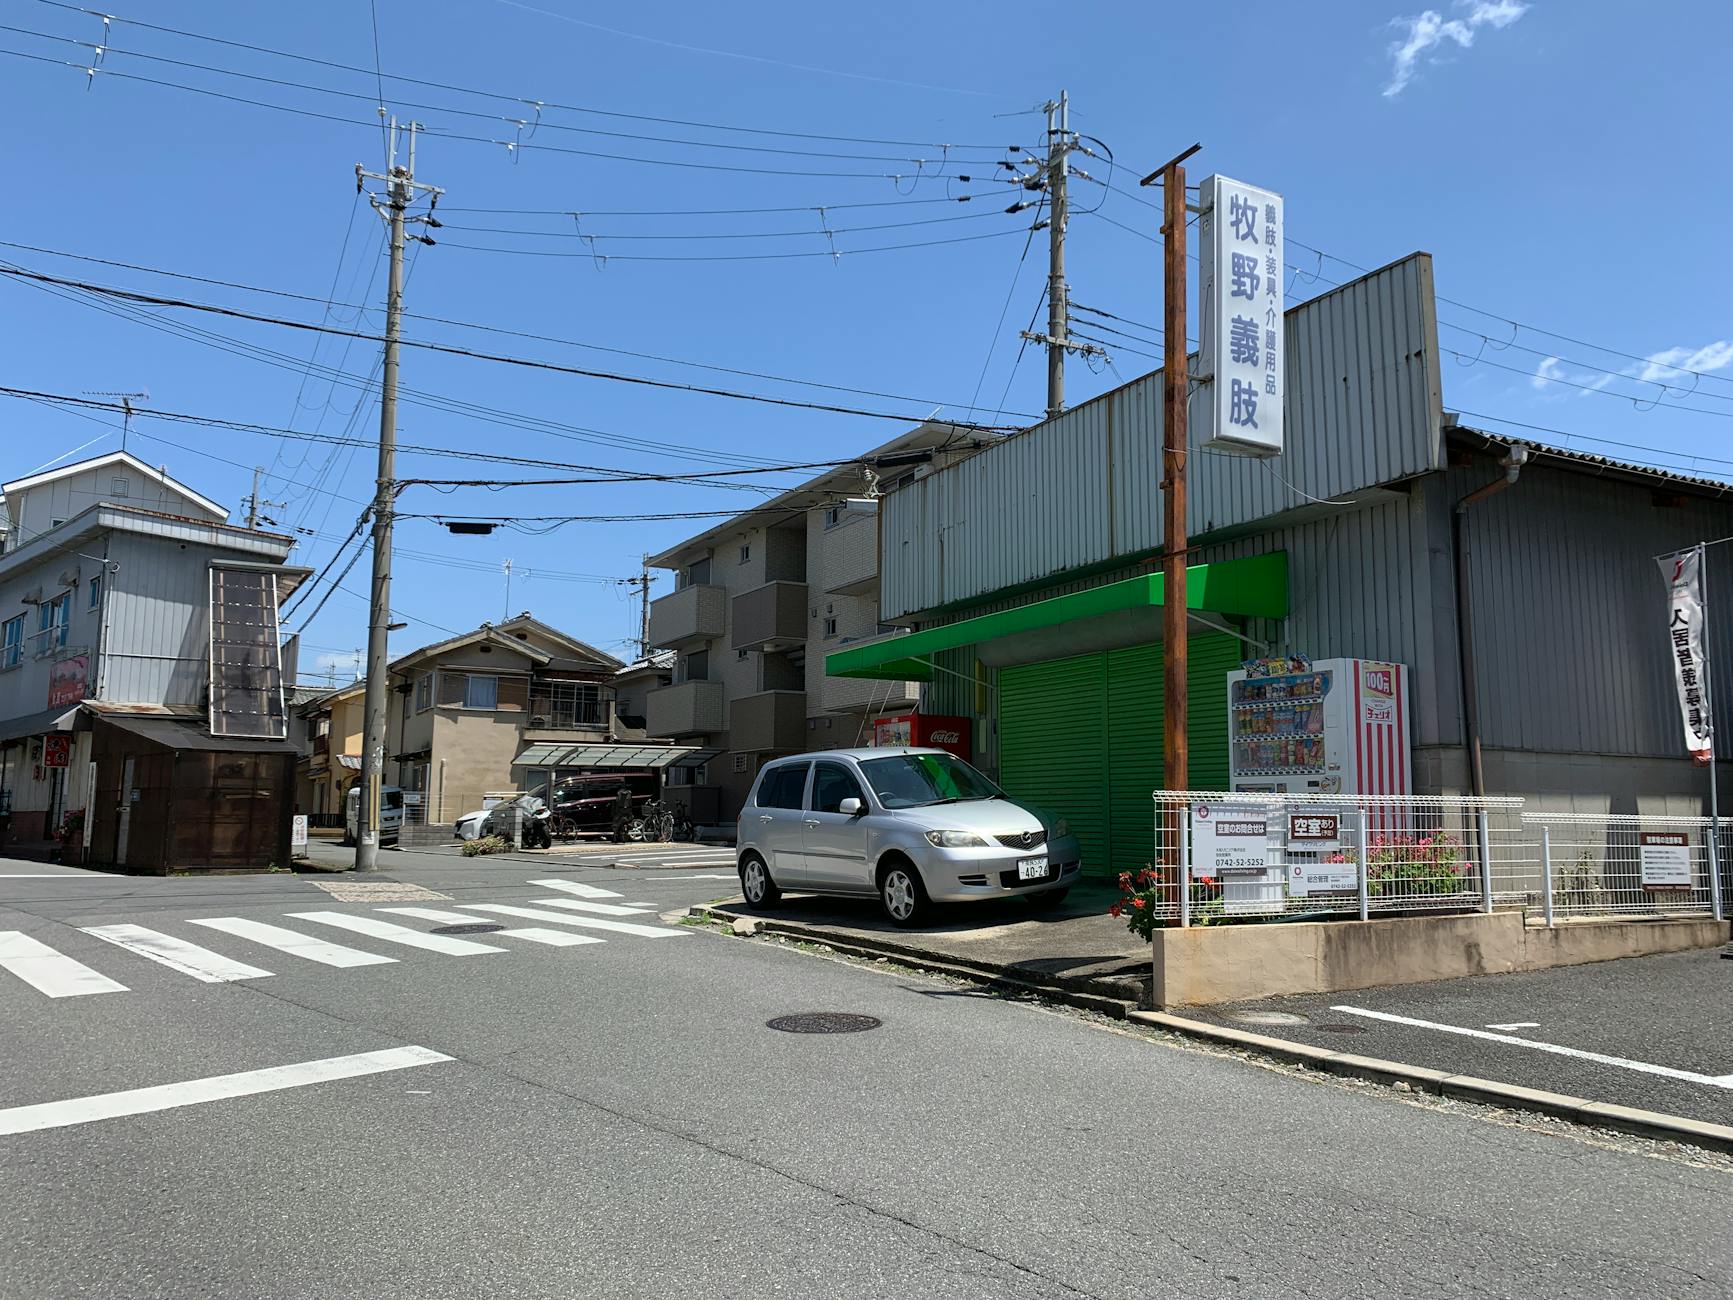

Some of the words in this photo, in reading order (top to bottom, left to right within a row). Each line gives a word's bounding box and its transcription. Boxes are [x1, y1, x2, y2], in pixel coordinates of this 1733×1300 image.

[1264, 204, 1276, 395] 義肢・装具・介護用品
[1229, 193, 1260, 429] 牧野義肢
[1367, 708, 1390, 719] チェリオ
[1217, 823, 1265, 834] 空室のお問合せは
[1294, 818, 1334, 837] 空室あり
[1215, 859, 1264, 867] 0742-52-5252
